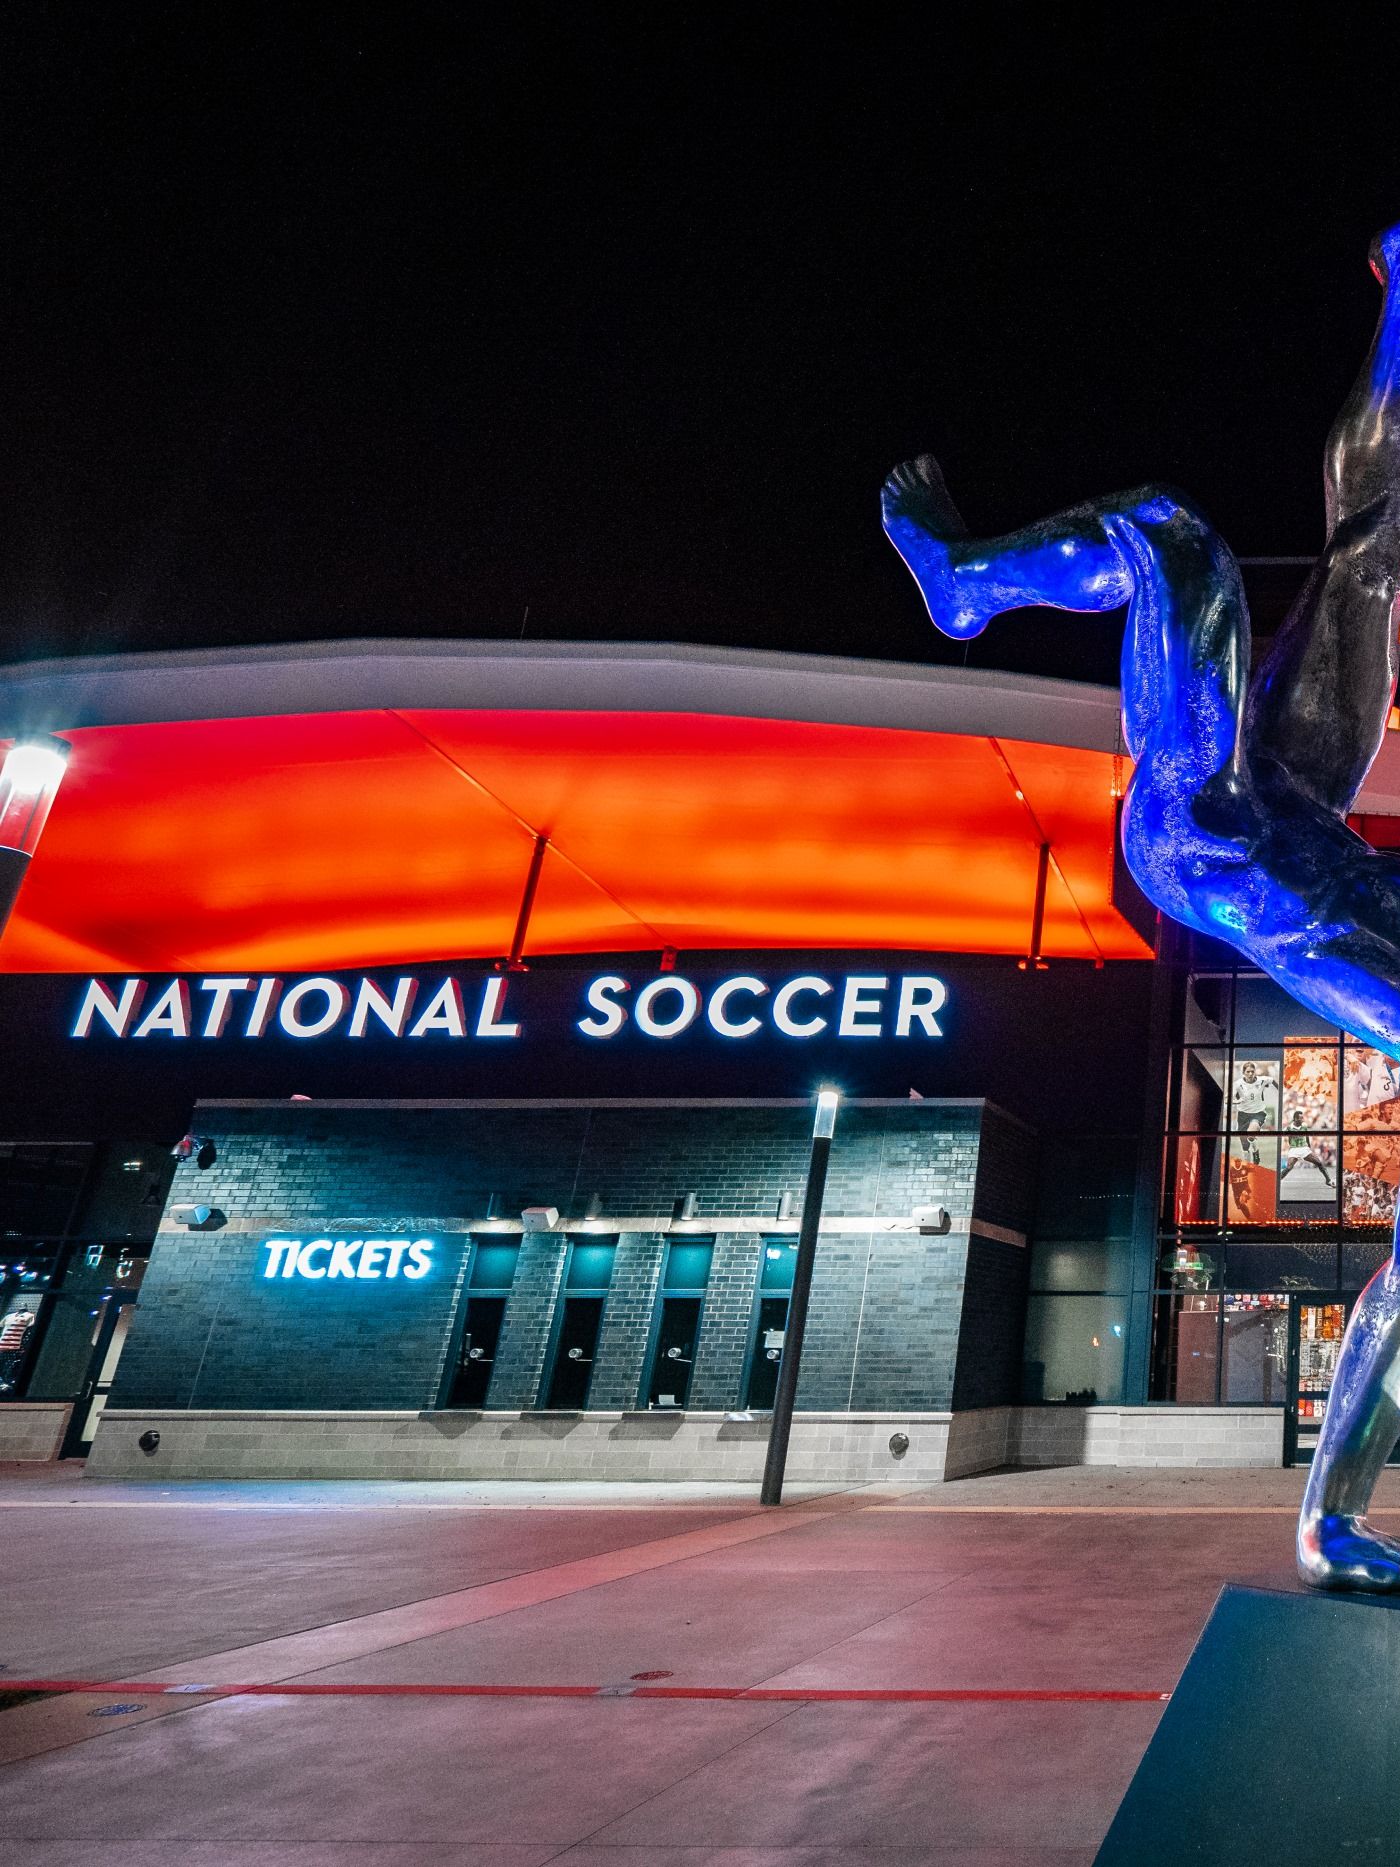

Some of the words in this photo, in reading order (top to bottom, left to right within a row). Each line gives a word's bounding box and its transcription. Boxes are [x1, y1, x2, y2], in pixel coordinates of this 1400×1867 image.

[72, 976, 521, 1037] NATIONAL
[577, 976, 948, 1037] SOCCER
[264, 1239, 434, 1279] TICKETS
